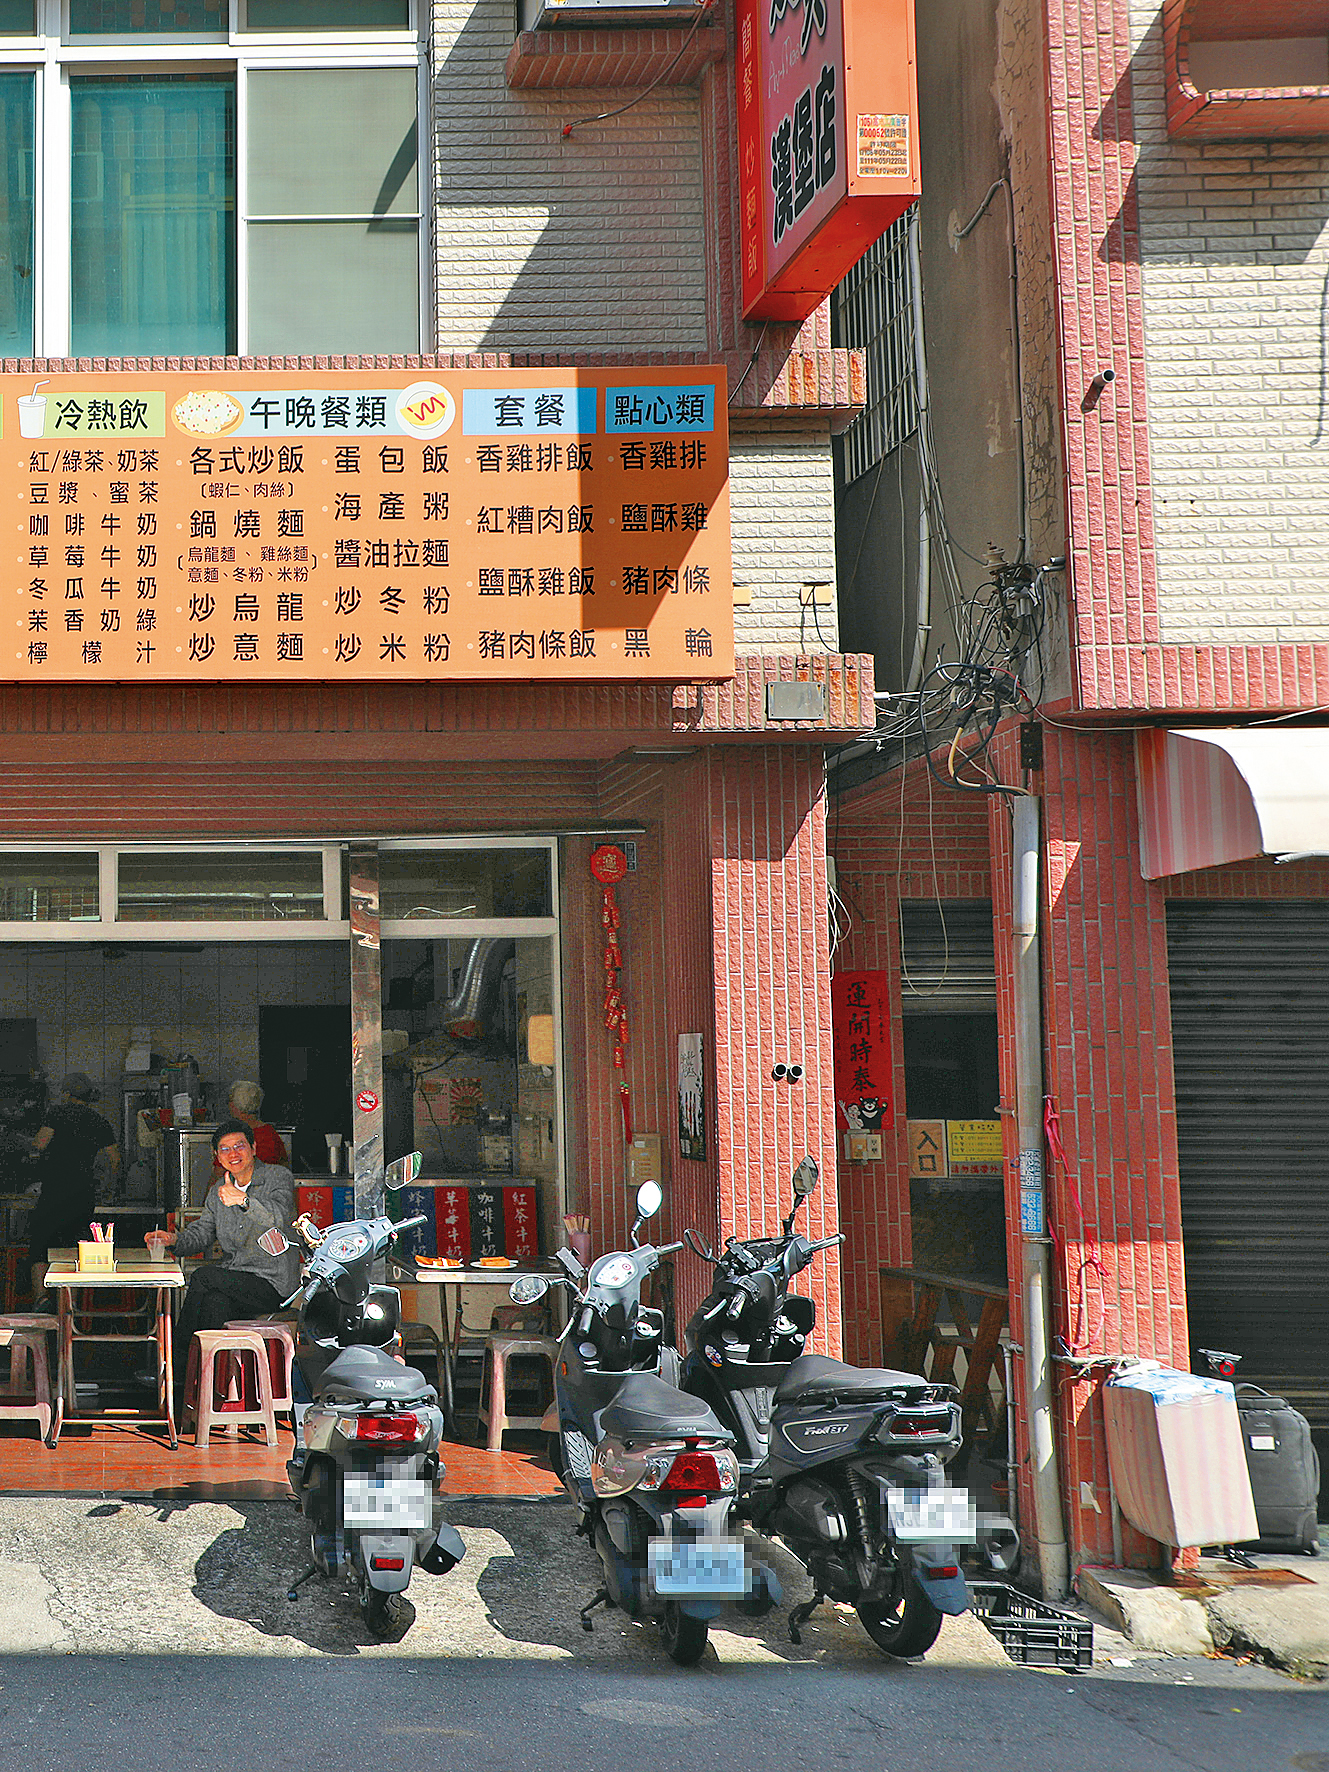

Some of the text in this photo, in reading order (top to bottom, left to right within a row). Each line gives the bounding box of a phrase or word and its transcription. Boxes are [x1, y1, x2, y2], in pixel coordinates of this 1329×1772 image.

[772, 64, 836, 248] 漢堡店
[55, 399, 148, 430] 冷熱飲
[250, 396, 386, 429] 午晚餐類
[494, 394, 565, 427] 套餐
[615, 394, 705, 425] 點心類
[190, 445, 304, 475] 各式炒飯
[335, 445, 449, 474] 蛋包飯
[476, 443, 593, 473] 香雞排飯
[620, 440, 706, 470] 香雞排
[335, 492, 448, 521] 海產粥
[477, 504, 594, 534] 紅糟肉飯
[621, 502, 708, 532] 鹽酥雞
[30, 513, 156, 536] 咖啡牛奶
[190, 509, 304, 538] 鍋燒麵
[29, 545, 156, 568] 草莓牛奶
[334, 539, 449, 568] 醬油拉麵
[29, 577, 156, 600] 冬瓜牛奶
[478, 567, 595, 596] 鹽酥雞飯
[622, 565, 709, 595] 豬肉條
[189, 592, 303, 622] 炒烏龍
[335, 586, 450, 615] 炒冬粉
[28, 608, 156, 632] 茉香奶綠
[28, 640, 156, 664] 檸檬汁
[189, 632, 303, 662] 炒意麵
[335, 633, 450, 662] 炒米粉
[479, 629, 596, 659] 豬肉條飯
[624, 628, 712, 657] 黑輪
[846, 980, 877, 1092] 運開時泰
[917, 1130, 939, 1172] 入口
[445, 1190, 462, 1257] 草莓牛奶
[477, 1192, 496, 1257] 咖啡牛奶
[512, 1191, 531, 1257] 紅茶牛奶
[375, 1380, 397, 1390] SYM
